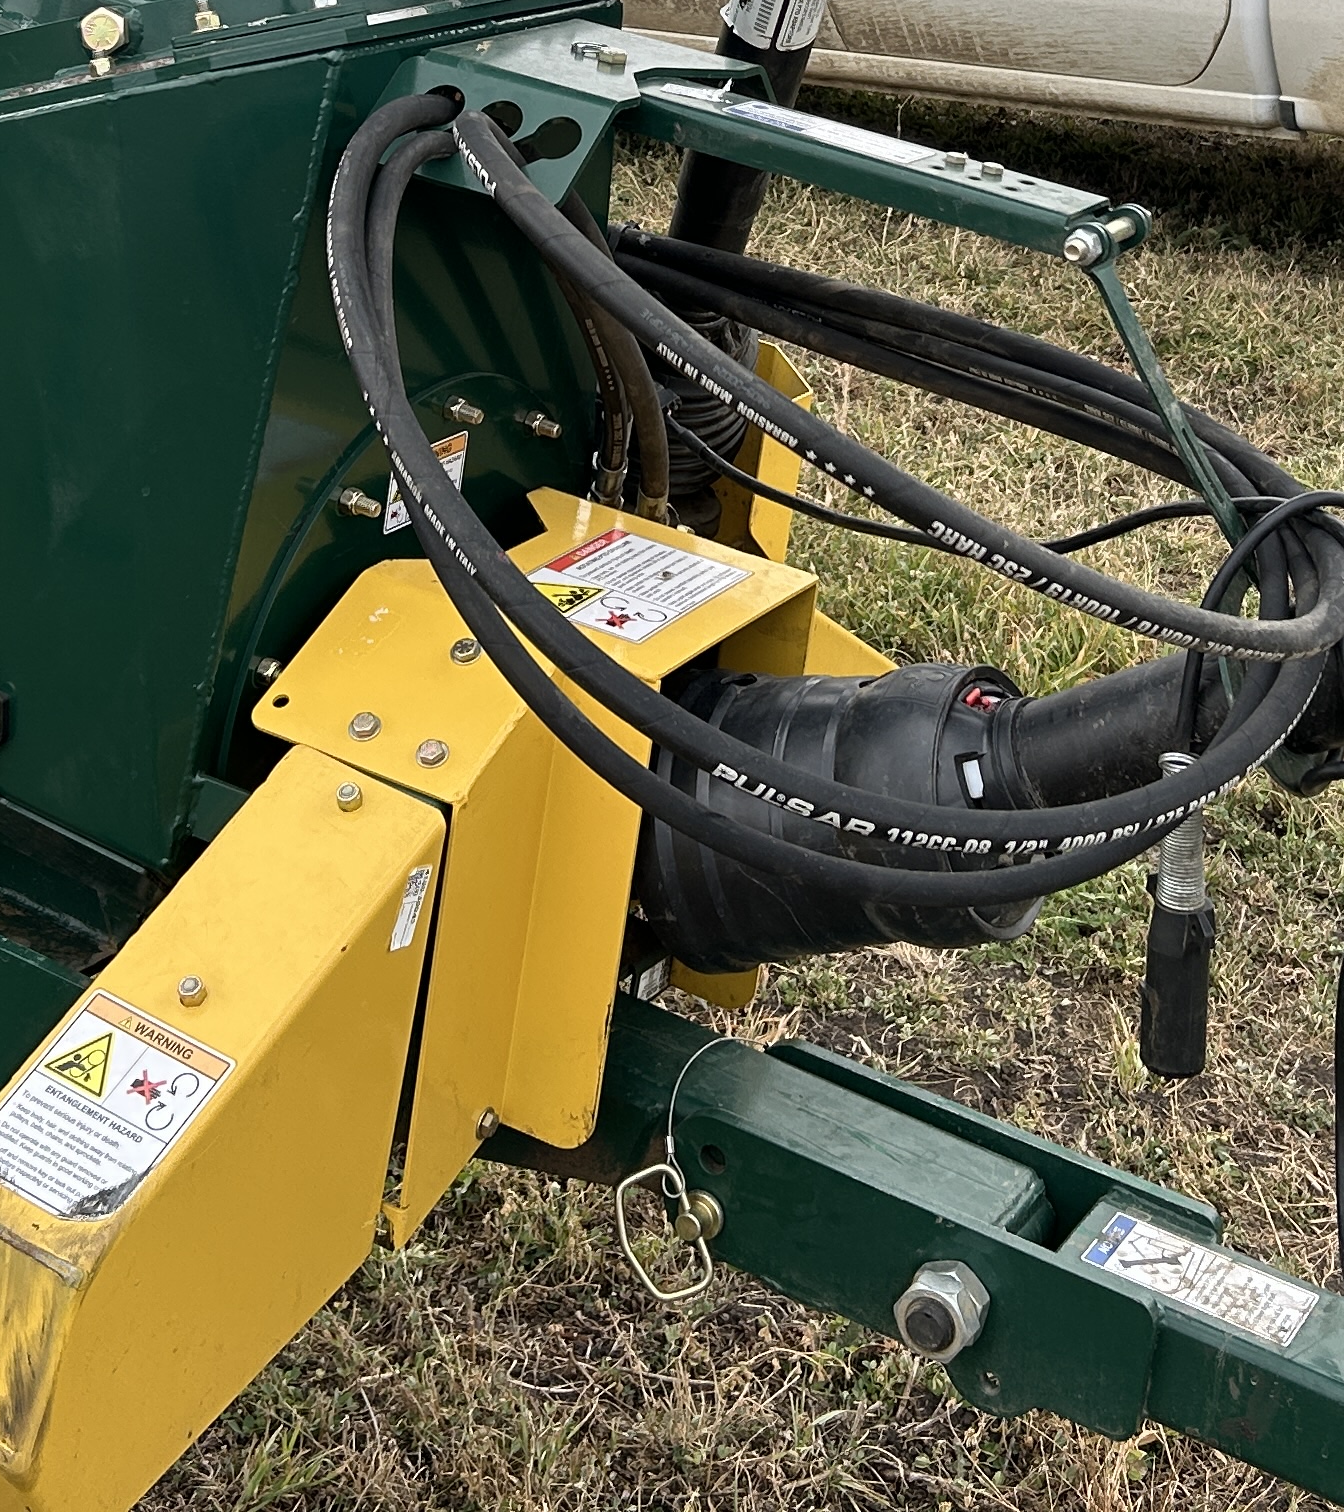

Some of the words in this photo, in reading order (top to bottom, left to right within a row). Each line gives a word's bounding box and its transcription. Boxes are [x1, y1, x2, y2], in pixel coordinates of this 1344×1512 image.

[655, 341, 683, 369] ITALY
[683, 361, 699, 381] IN
[699, 373, 733, 405] MADE
[736, 401, 799, 448] ABRASION
[390, 450, 423, 504] ABRASION
[423, 503, 446, 537] MADE
[445, 533, 457, 551] IN
[455, 547, 477, 577] ITALY
[927, 520, 988, 562] HARC
[989, 552, 1032, 584] 2SC
[1043, 581, 1122, 624] 100R19
[886, 828, 992, 855] 112CC-08
[1110, 821, 1141, 842] PSI
[1154, 806, 1184, 827] 275
[134, 1021, 194, 1060] WARNING
[15, 1103, 31, 1115] Keep
[57, 1127, 70, 1136] and
[67, 1133, 90, 1149] clothing
[88, 1145, 105, 1157] away
[103, 1153, 118, 1163] from
[20, 1089, 32, 1098] To
[30, 1095, 55, 1112] prevent
[52, 1107, 77, 1124] serious
[74, 1120, 94, 1135] injury
[92, 1130, 102, 1139] or
[44, 1084, 109, 1124] ENTANGLEMENT
[107, 1120, 144, 1144] HAZARD
[0, 1121, 11, 1130] Do
[9, 1126, 20, 1135] not
[17, 1131, 39, 1146] operate
[38, 1143, 52, 1153] with
[49, 1150, 61, 1159] any
[60, 1155, 78, 1168] guard
[76, 1164, 101, 1181] removed
[17, 1142, 34, 1154] Keep
[32, 1150, 53, 1165] guards
[57, 1164, 73, 1176] good
[71, 1172, 94, 1188] working
[63, 1141, 76, 1150] and
[6, 1151, 18, 1160] and
[36, 1168, 48, 1178] key
[65, 1185, 76, 1194] out
